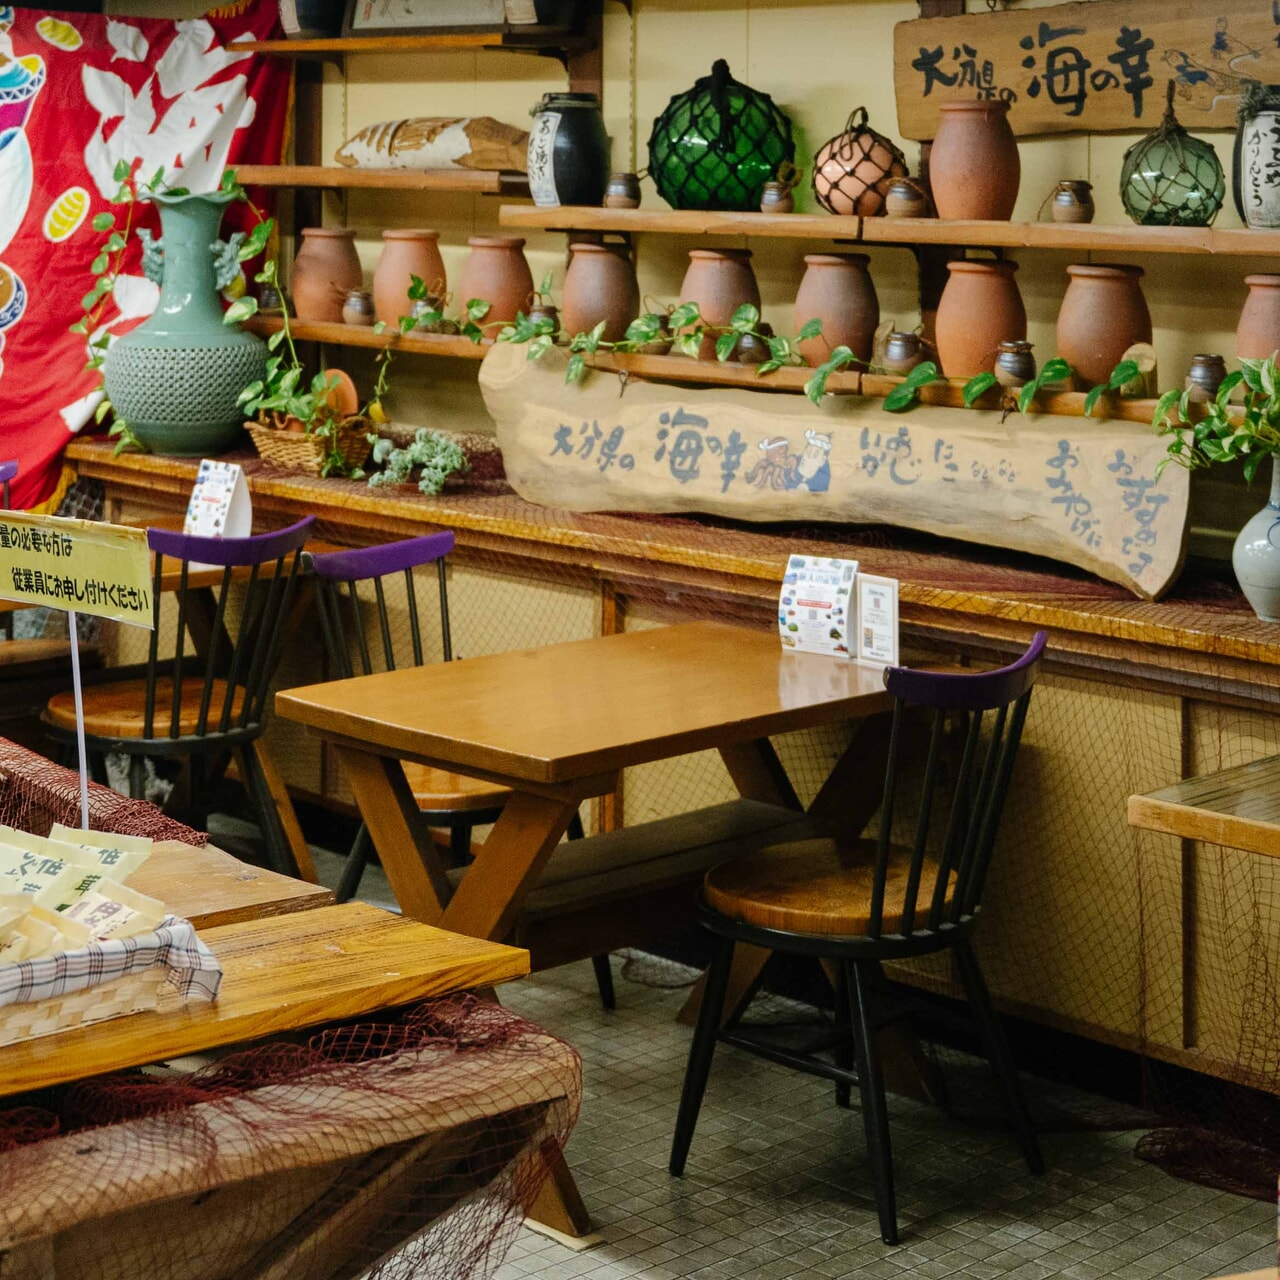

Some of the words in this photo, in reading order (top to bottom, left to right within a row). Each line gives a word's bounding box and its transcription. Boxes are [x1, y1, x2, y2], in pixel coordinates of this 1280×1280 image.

[10, 566, 150, 612] 従業員にお申し付けください
